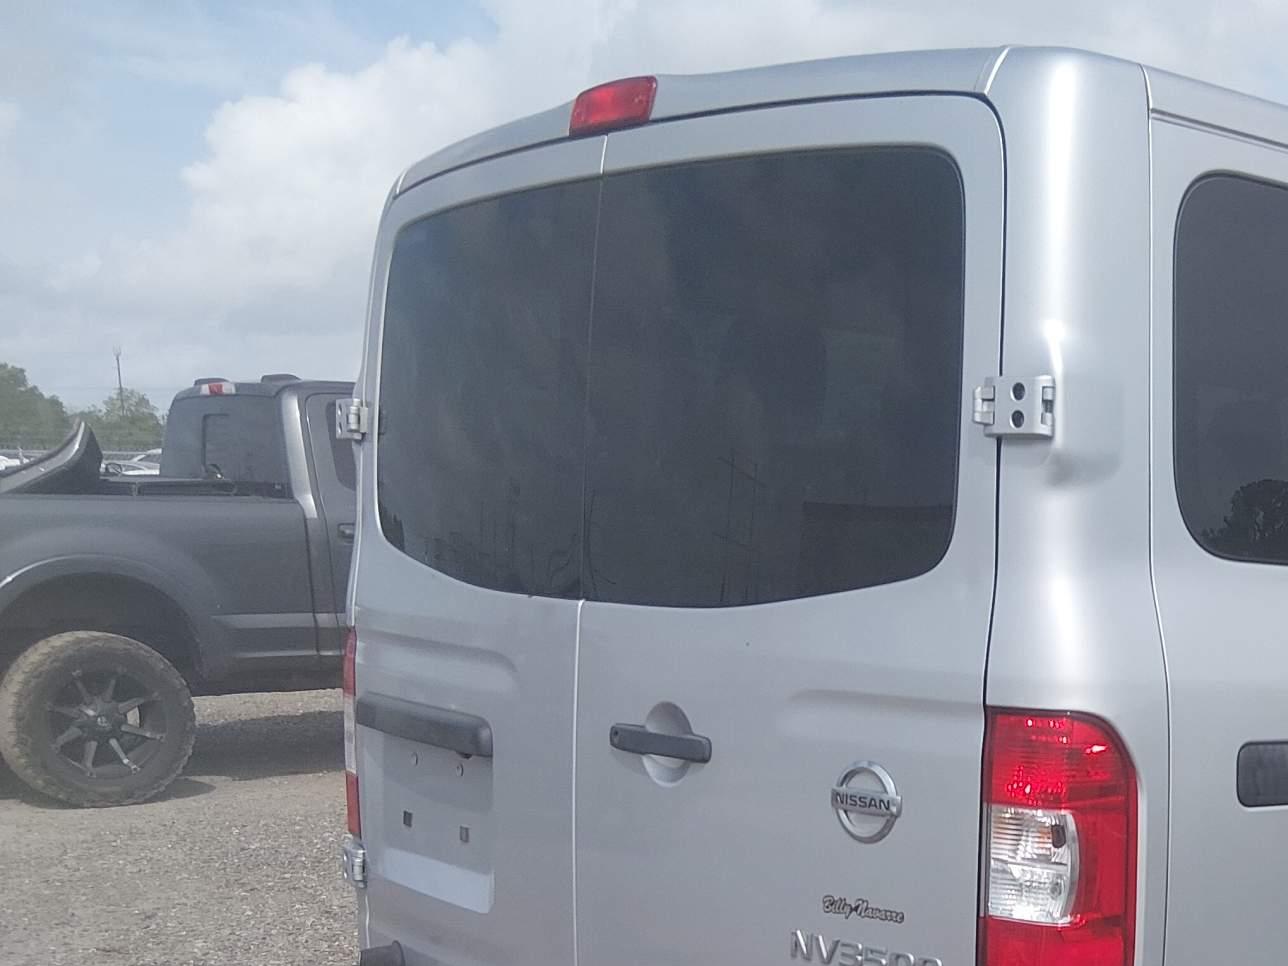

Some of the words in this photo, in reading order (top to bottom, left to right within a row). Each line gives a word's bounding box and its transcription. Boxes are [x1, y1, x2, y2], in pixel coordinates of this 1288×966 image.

[835, 791, 891, 811] NISSAN
[822, 895, 853, 920] Billy
[854, 898, 905, 924] Navarre
